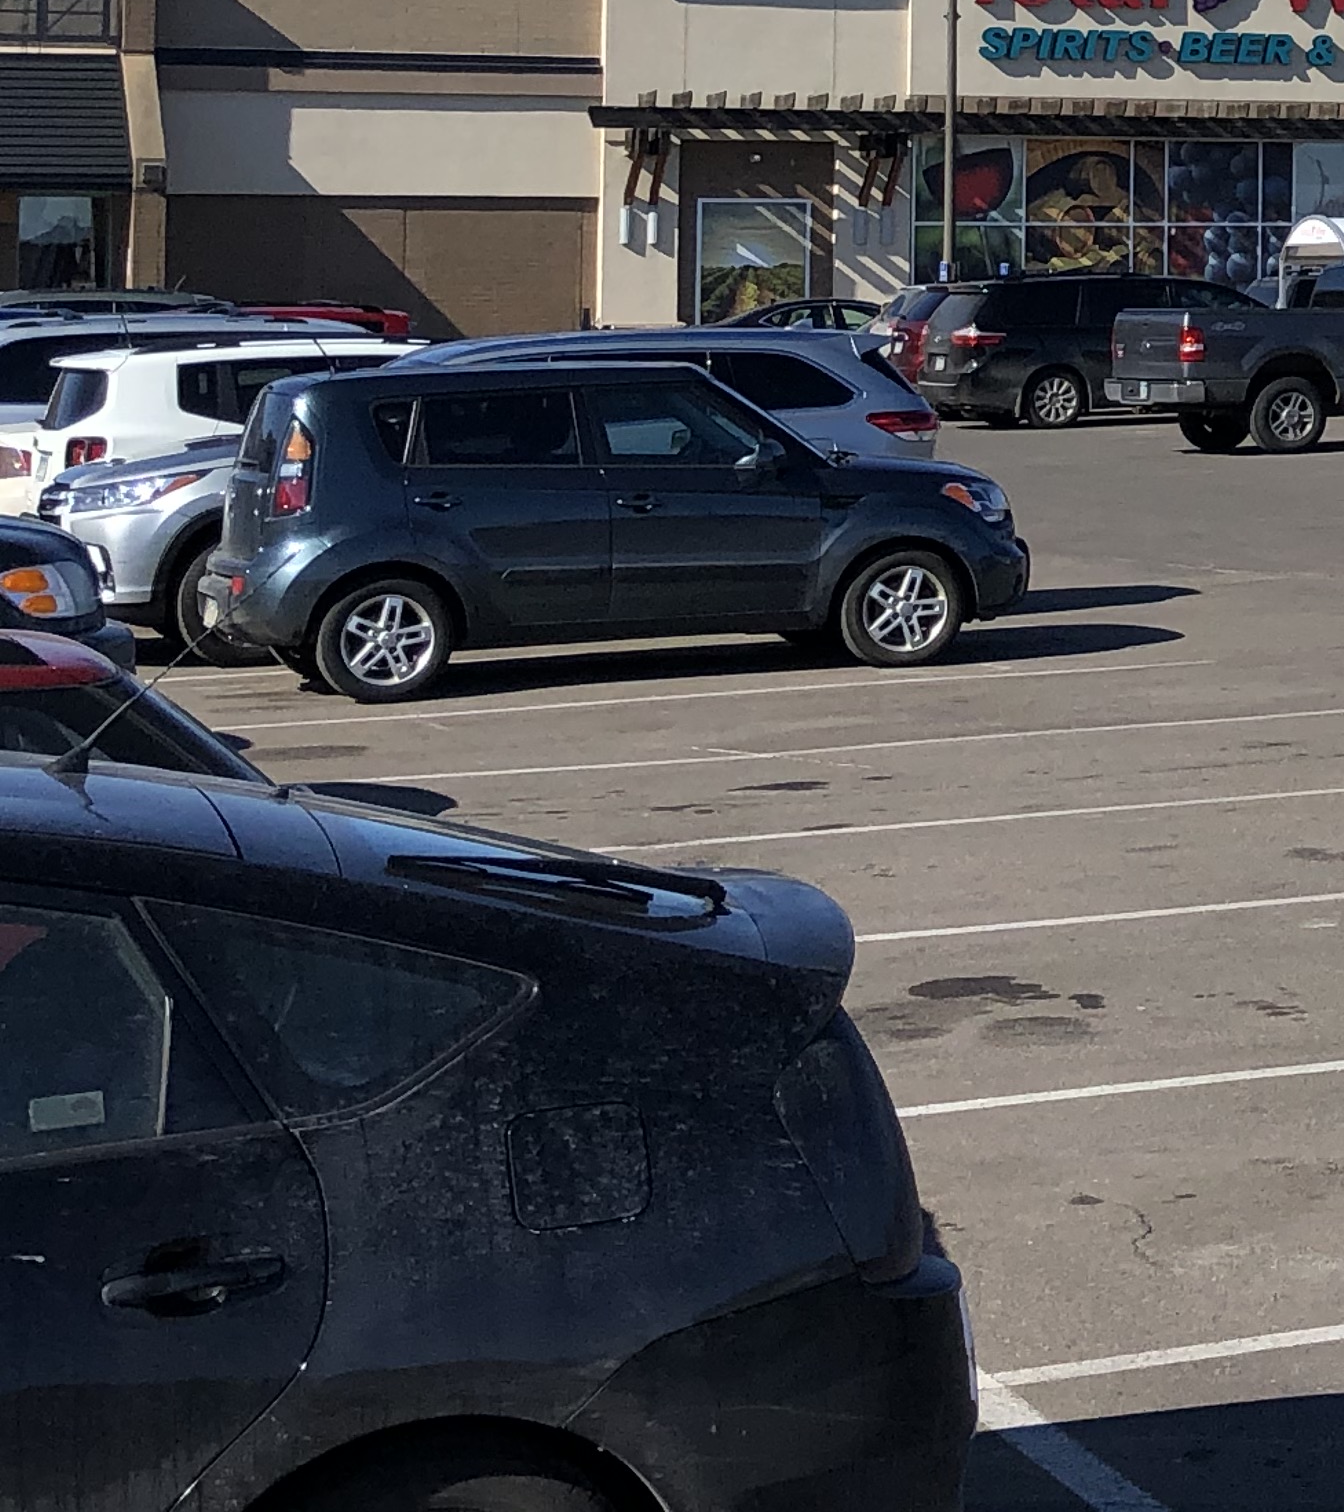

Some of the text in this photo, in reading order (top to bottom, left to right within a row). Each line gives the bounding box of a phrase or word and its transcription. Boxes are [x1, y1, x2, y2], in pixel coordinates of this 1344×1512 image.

[979, 27, 1154, 62] SPIRITS
[1178, 31, 1294, 65] BEER
[1306, 34, 1335, 66] &
